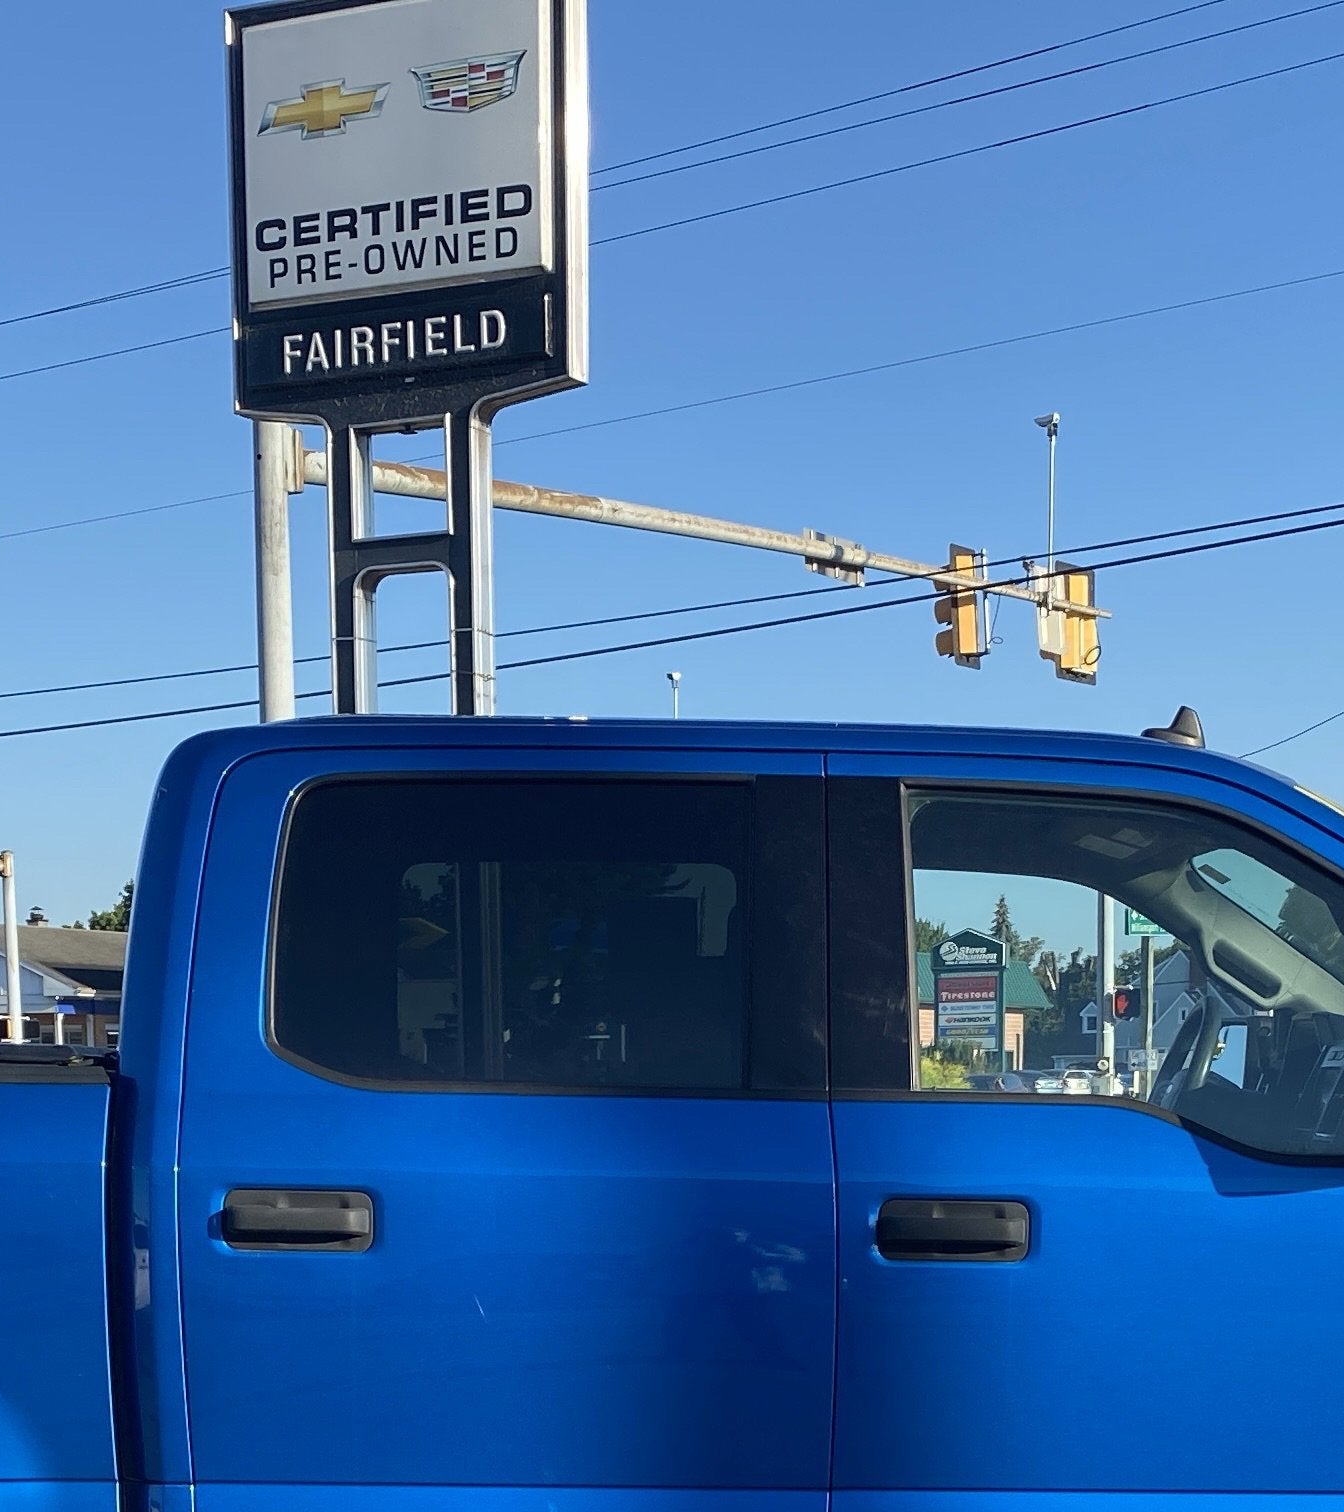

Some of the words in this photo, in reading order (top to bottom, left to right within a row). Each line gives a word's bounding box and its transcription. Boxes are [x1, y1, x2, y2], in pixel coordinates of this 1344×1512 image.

[256, 184, 532, 252] CERTIFIED
[269, 226, 518, 289] PRE-OWNED
[282, 309, 507, 375] FAIRFIELD
